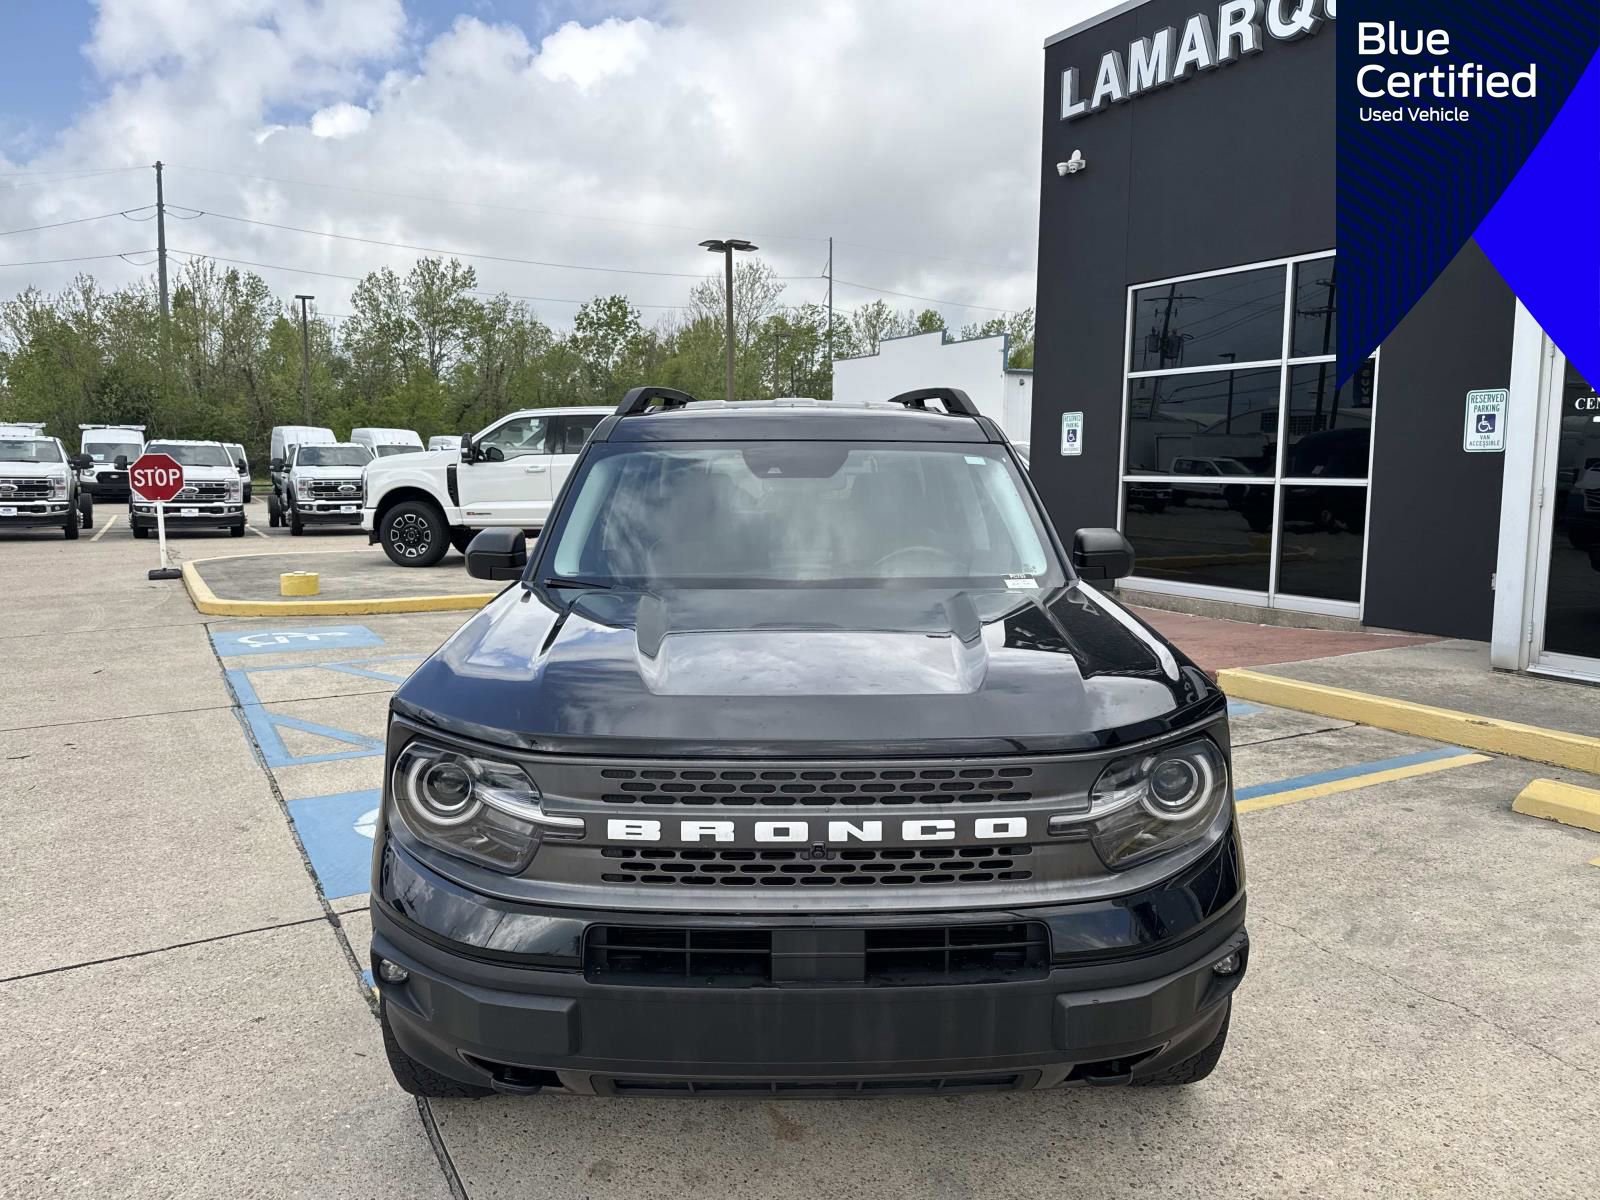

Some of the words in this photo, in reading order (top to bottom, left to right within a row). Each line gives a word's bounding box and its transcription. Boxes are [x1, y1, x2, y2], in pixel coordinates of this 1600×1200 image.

[1060, 0, 1336, 120] LAMARQ
[1470, 393, 1505, 404] RESERVED
[1473, 404, 1500, 413] PARKING
[133, 468, 180, 487] STOP
[607, 817, 1027, 842] BRONCO
